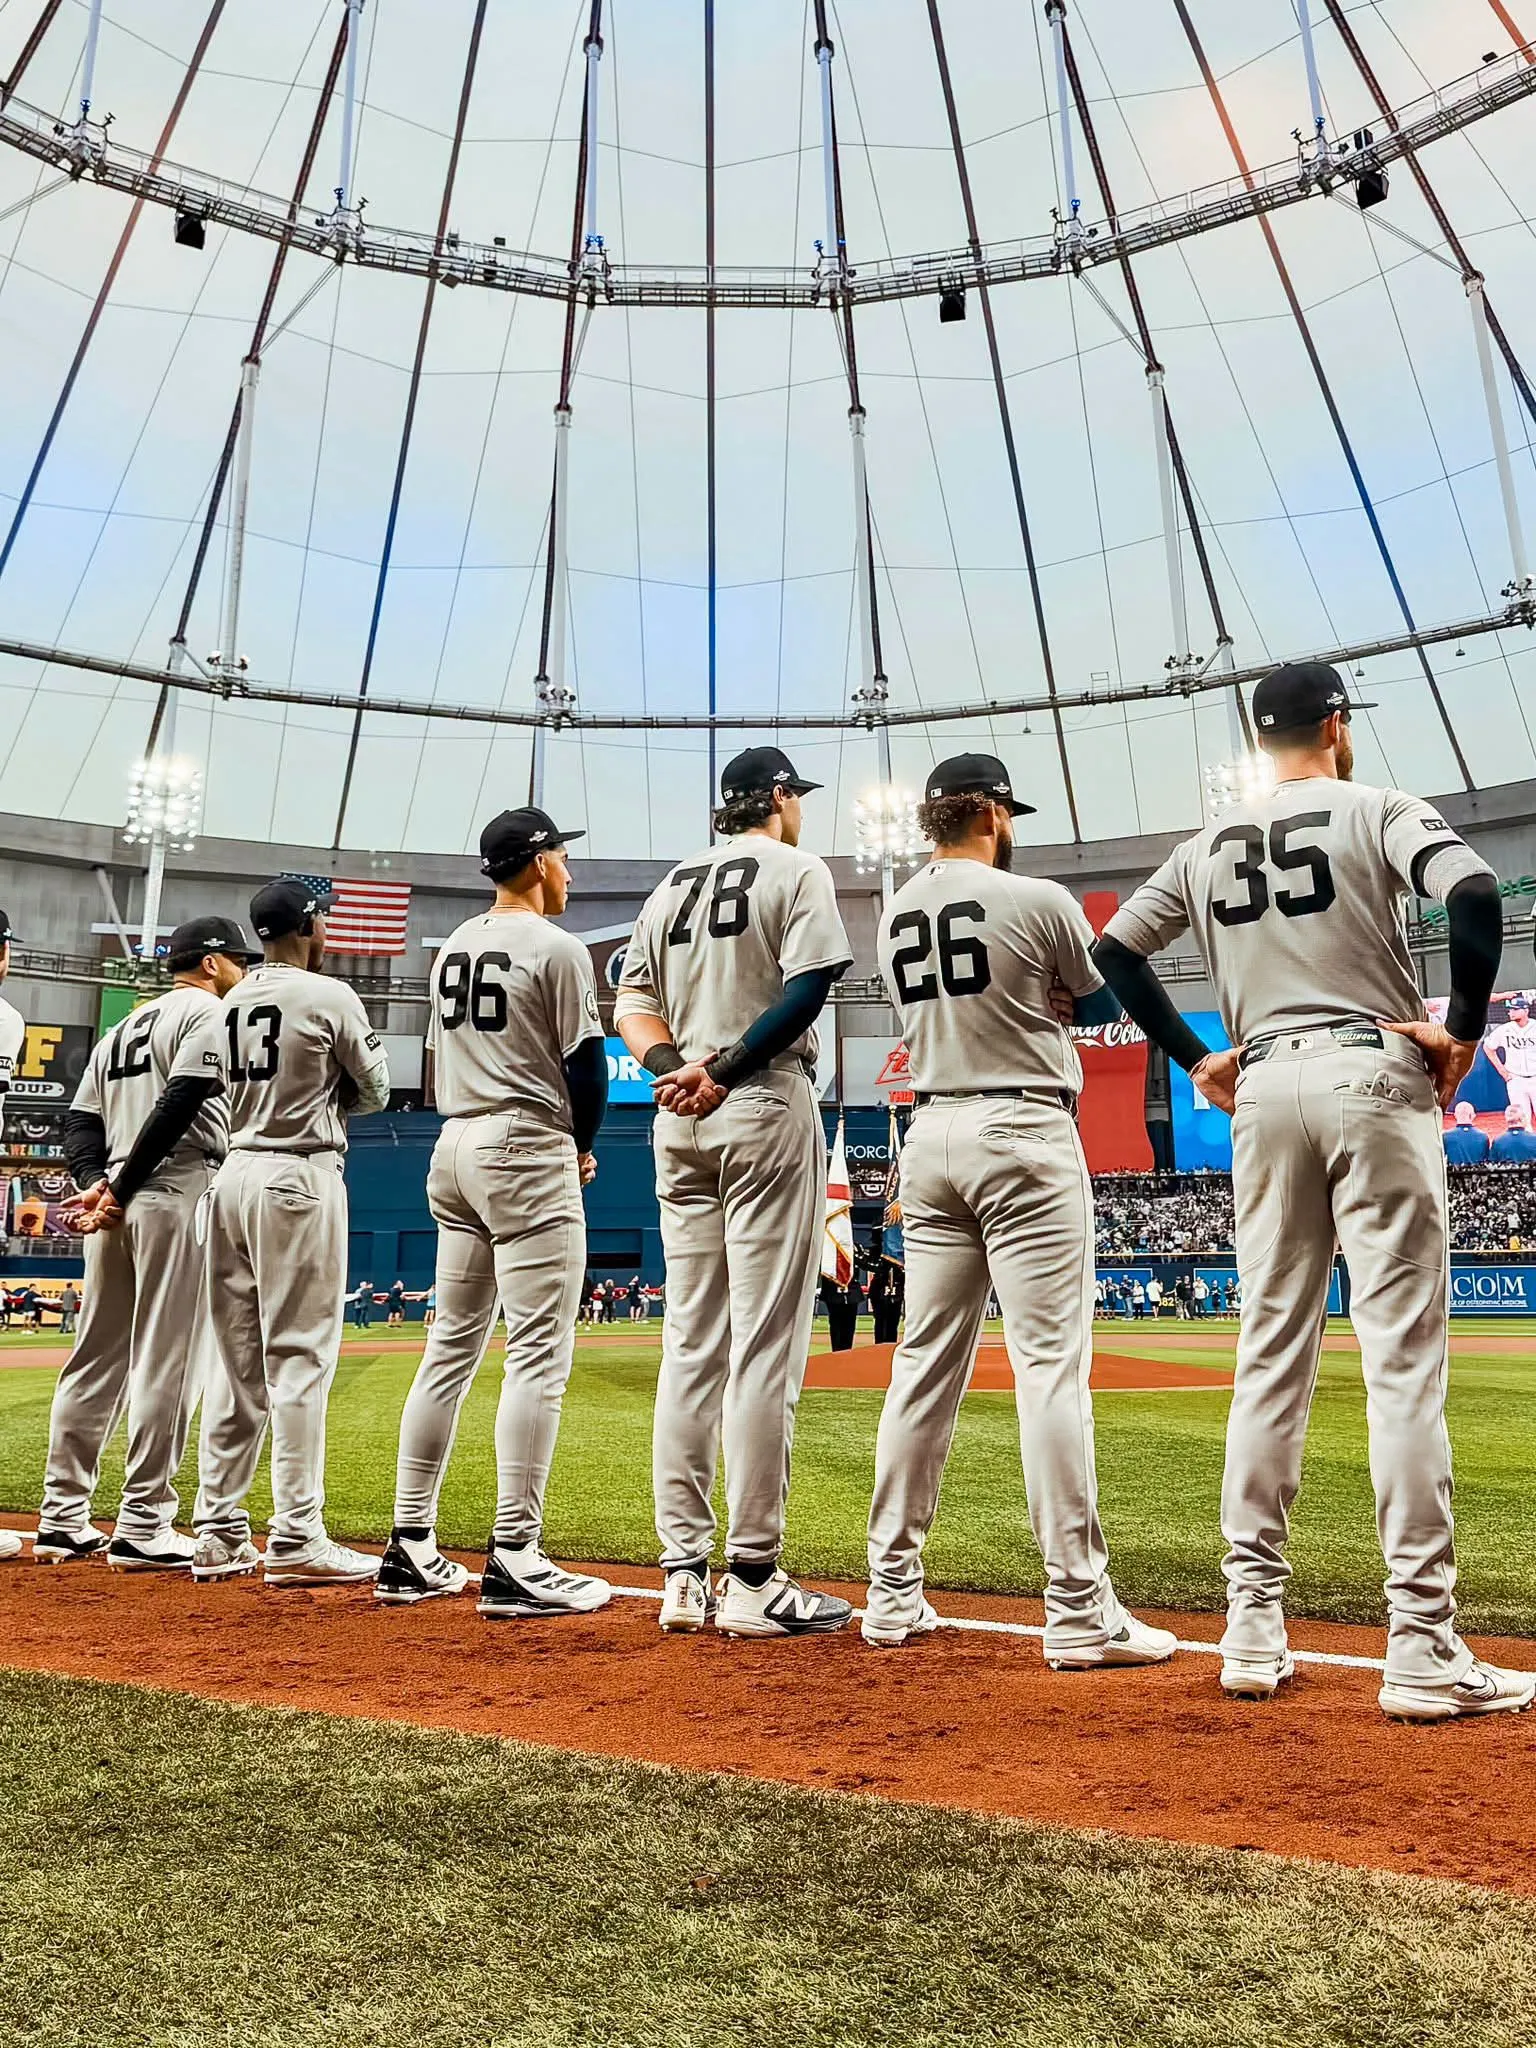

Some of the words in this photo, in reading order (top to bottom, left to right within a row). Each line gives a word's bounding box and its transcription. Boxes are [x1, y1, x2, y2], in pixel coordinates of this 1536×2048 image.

[667, 857, 760, 947] 78
[1208, 810, 1336, 927] 35
[438, 951, 512, 1032] 96
[889, 900, 992, 1005] 26
[107, 1008, 161, 1082] 12
[224, 1004, 282, 1083] 13
[13, 1083, 53, 1094] OUP
